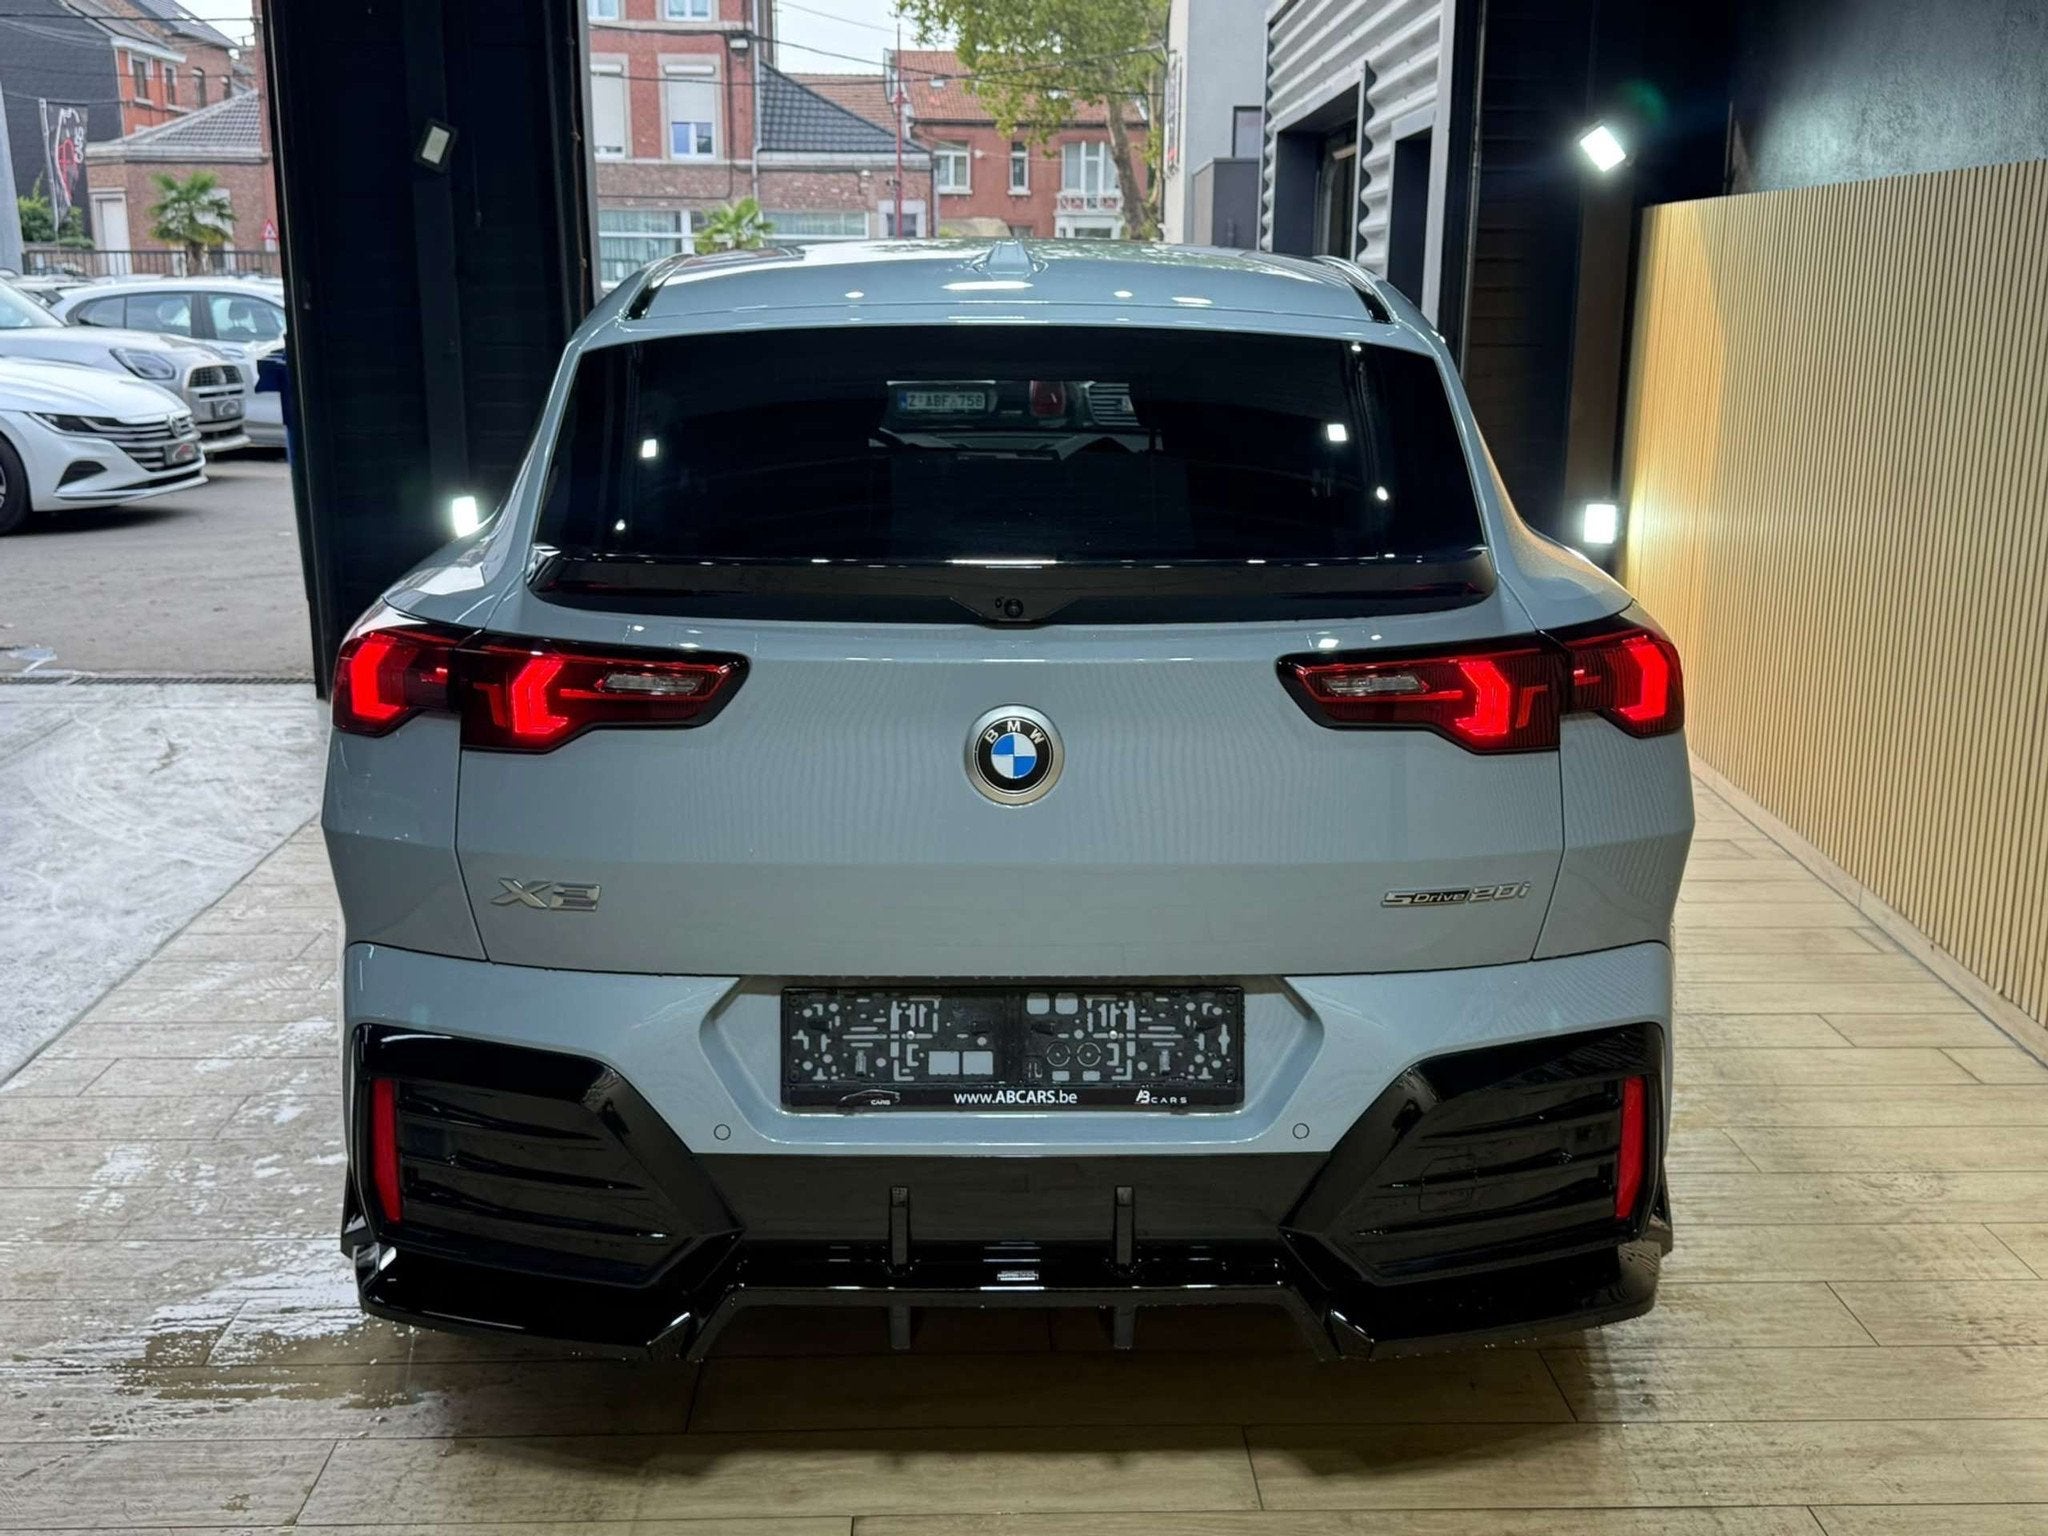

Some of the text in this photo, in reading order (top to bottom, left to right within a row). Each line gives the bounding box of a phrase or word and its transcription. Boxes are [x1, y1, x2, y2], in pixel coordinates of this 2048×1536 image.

[984, 720, 1045, 744] BMW
[489, 876, 601, 911] X2
[953, 1090, 1078, 1104] www.ABCARS.be
